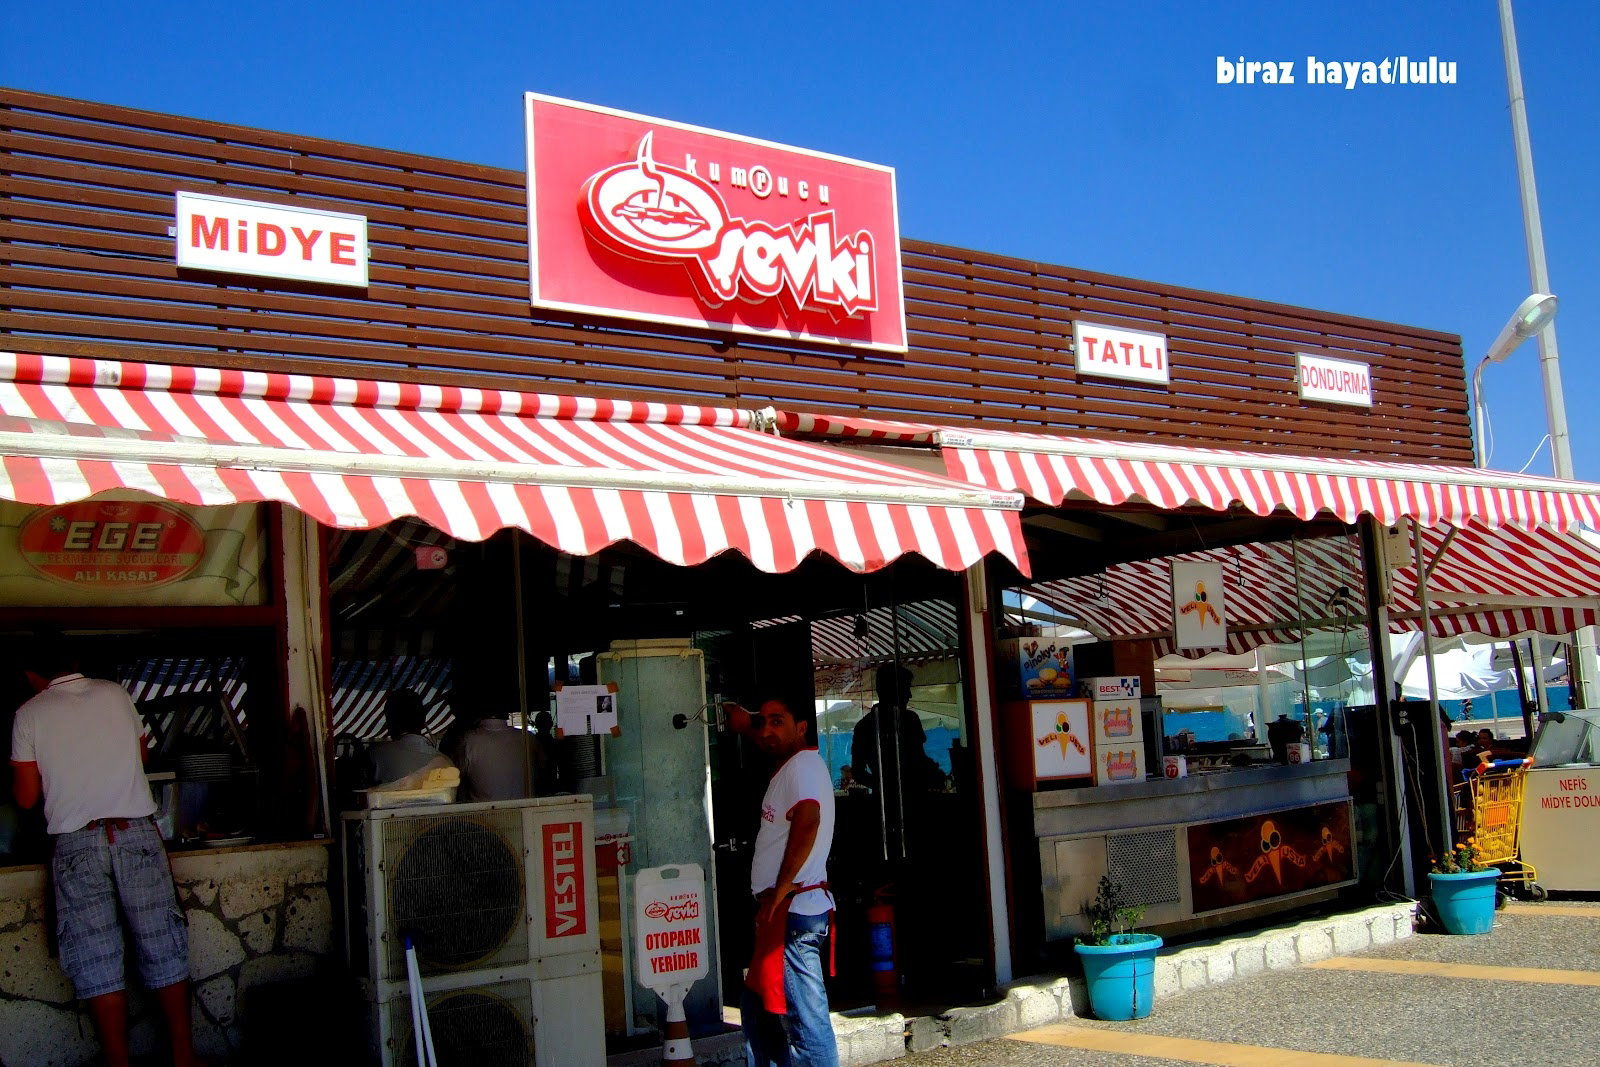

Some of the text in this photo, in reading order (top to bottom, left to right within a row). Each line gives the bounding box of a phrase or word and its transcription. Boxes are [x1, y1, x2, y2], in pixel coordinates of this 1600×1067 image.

[1082, 336, 1163, 371] TATLI
[1300, 364, 1370, 396] DONDURMA
[63, 521, 163, 551] EGE
[106, 570, 159, 582] KASAP
[1024, 644, 1056, 672] Pinokyo
[1100, 685, 1121, 693] BEST
[1559, 775, 1587, 791] NEFİS
[1541, 794, 1571, 809] MİDYE
[552, 823, 578, 936] VESTEL
[645, 927, 701, 951] OTOPARK
[650, 950, 698, 974] YERİDİR
